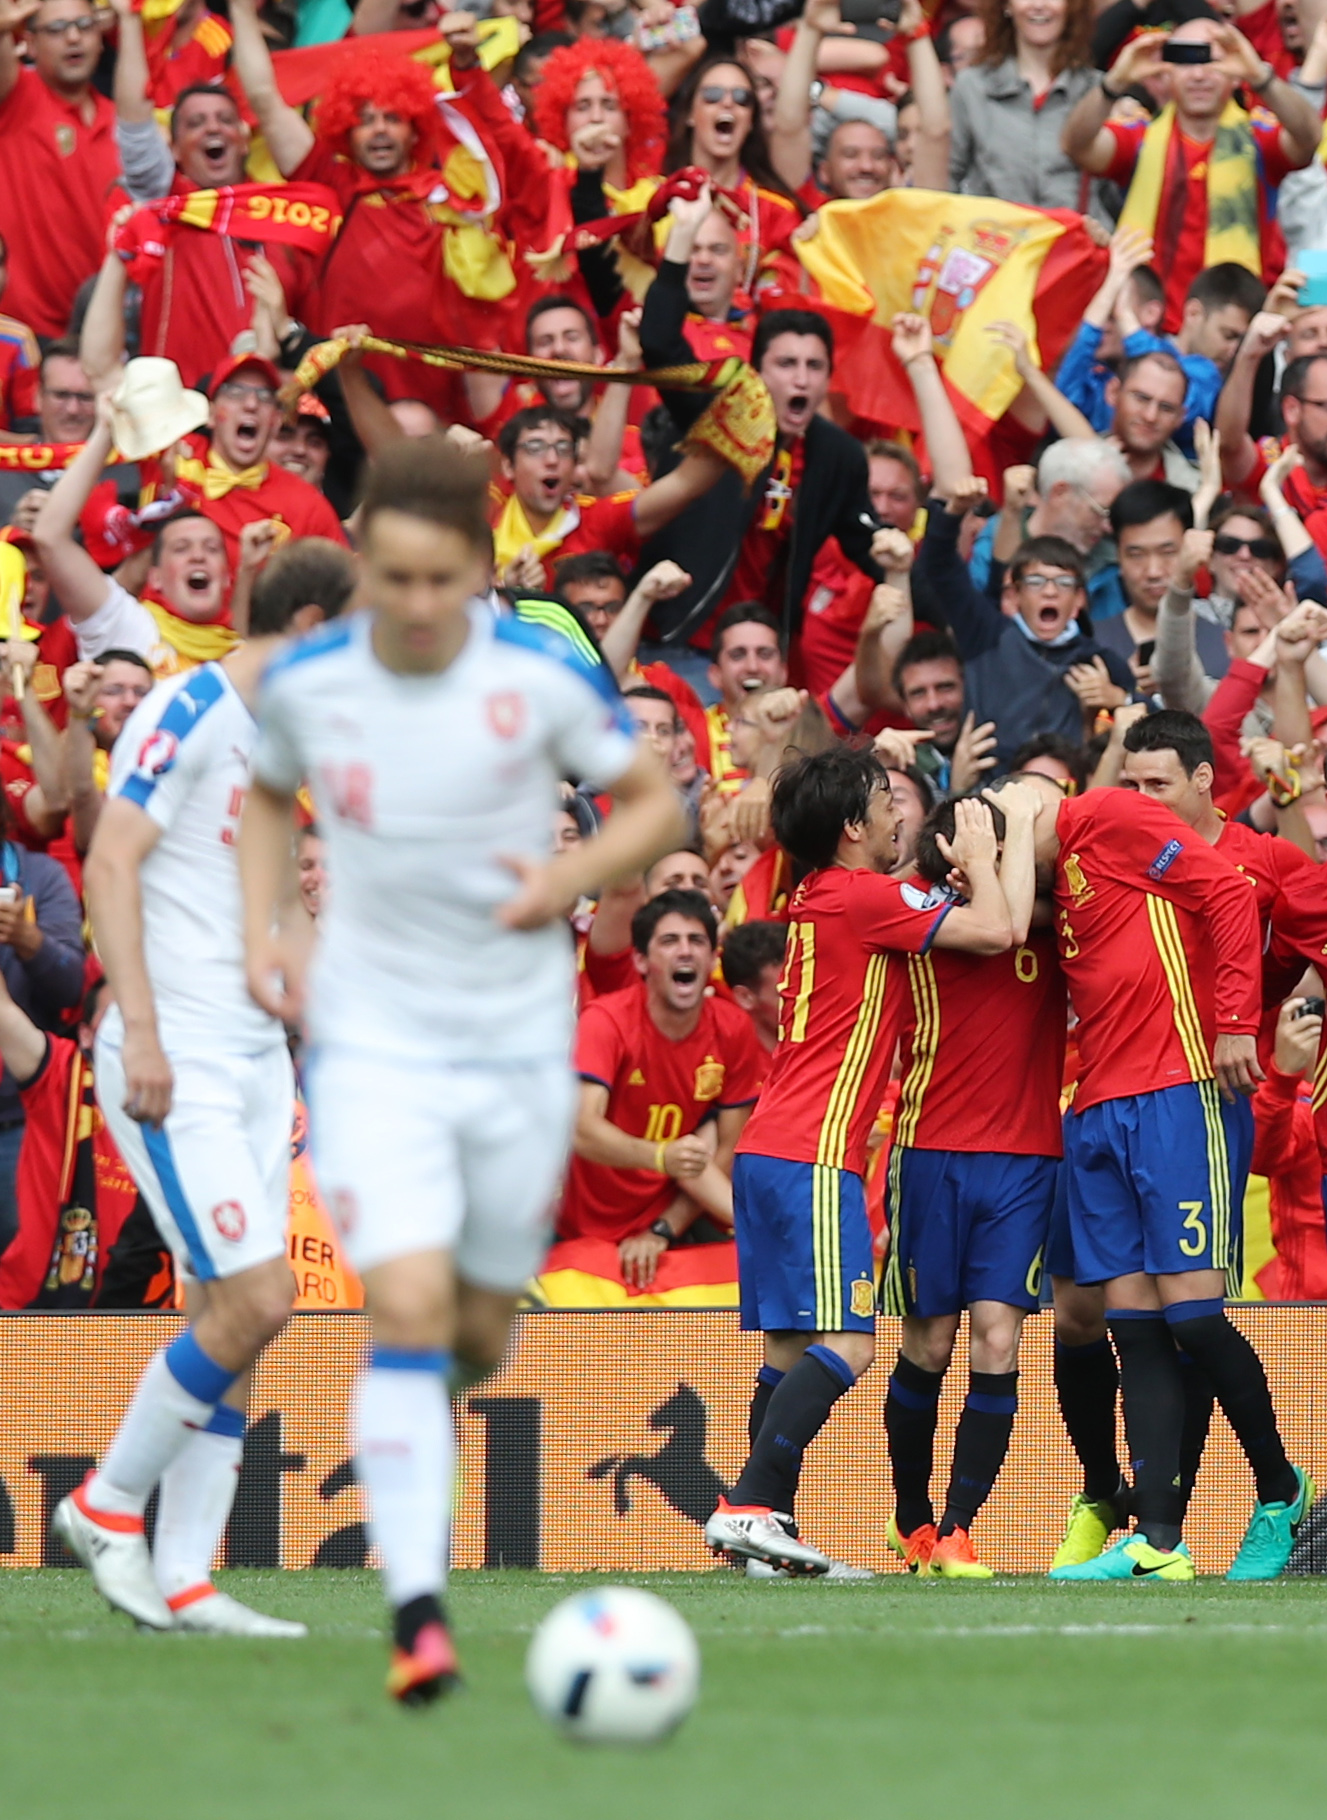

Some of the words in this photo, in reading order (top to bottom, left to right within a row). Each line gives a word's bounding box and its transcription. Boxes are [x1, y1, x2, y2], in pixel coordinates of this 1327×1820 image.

[248, 195, 331, 233] 2016
[644, 1103, 684, 1142] 10
[1178, 1200, 1207, 1258] 3
